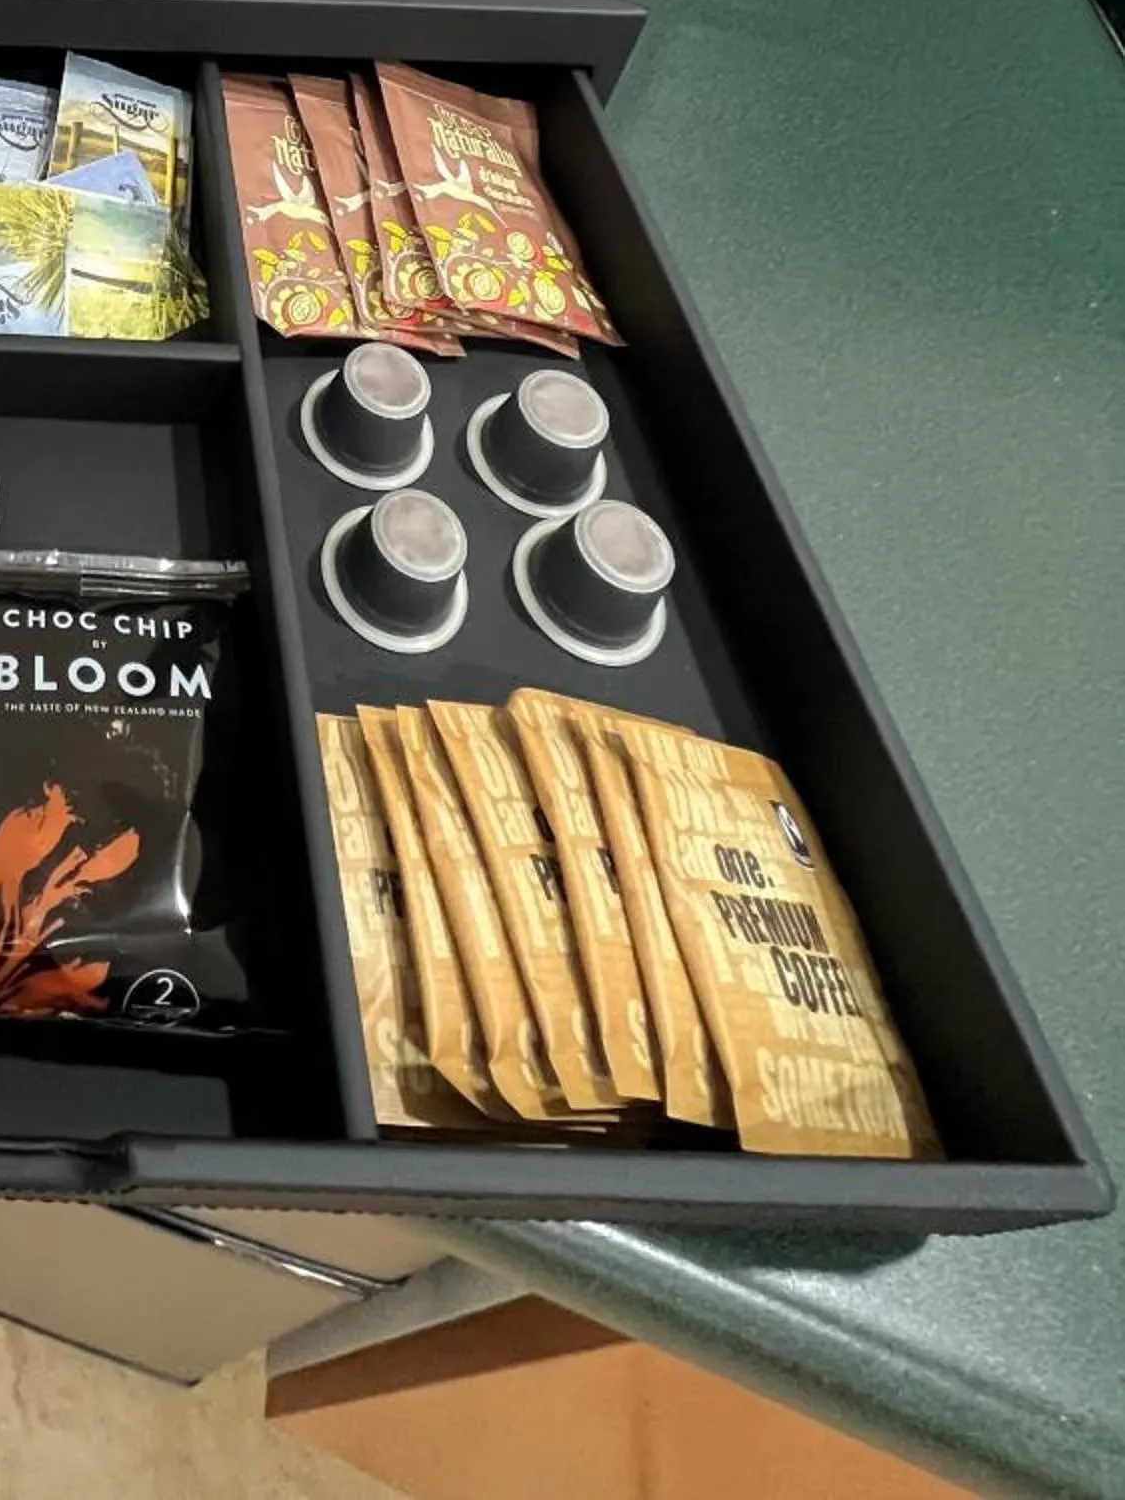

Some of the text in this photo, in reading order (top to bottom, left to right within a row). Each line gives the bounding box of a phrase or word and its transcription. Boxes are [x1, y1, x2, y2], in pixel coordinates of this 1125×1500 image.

[3, 609, 194, 639] CHOC CHIP
[92, 639, 108, 649] BY
[4, 702, 202, 718] THE TASTE OF NEW ZEALAND MADE
[710, 889, 830, 954] PREMIUM
[155, 977, 174, 1005] 2
